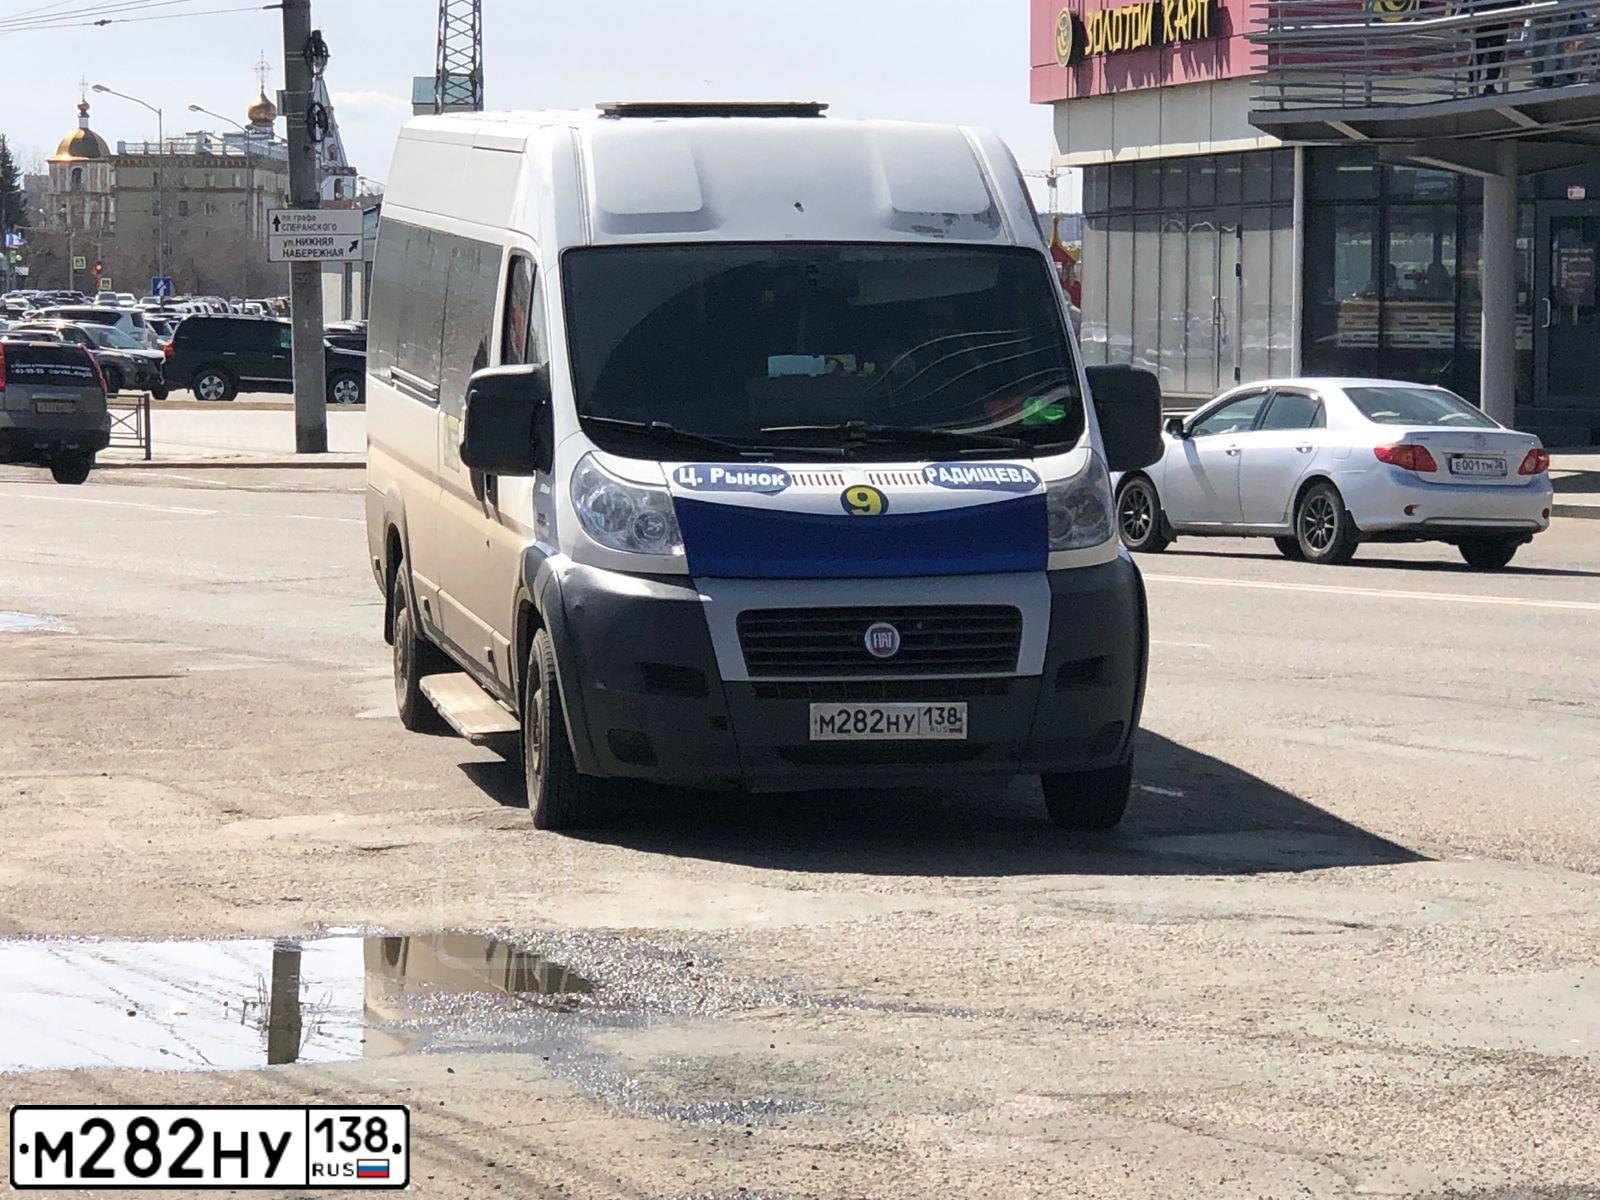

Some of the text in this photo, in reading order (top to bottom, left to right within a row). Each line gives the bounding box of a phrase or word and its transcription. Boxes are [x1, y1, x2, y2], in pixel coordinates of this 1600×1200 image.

[1163, 0, 1210, 45] КАРП
[281, 223, 338, 232] СПЕРАНСКОГО
[282, 248, 344, 258] НАБЕРЕЖНАЯ
[678, 467, 786, 486] Ц. Рынок
[926, 467, 1037, 485] РАДИЩЕВА
[846, 486, 882, 516] 9
[873, 632, 892, 648] FIAT
[819, 706, 958, 734] М282НУ 138
